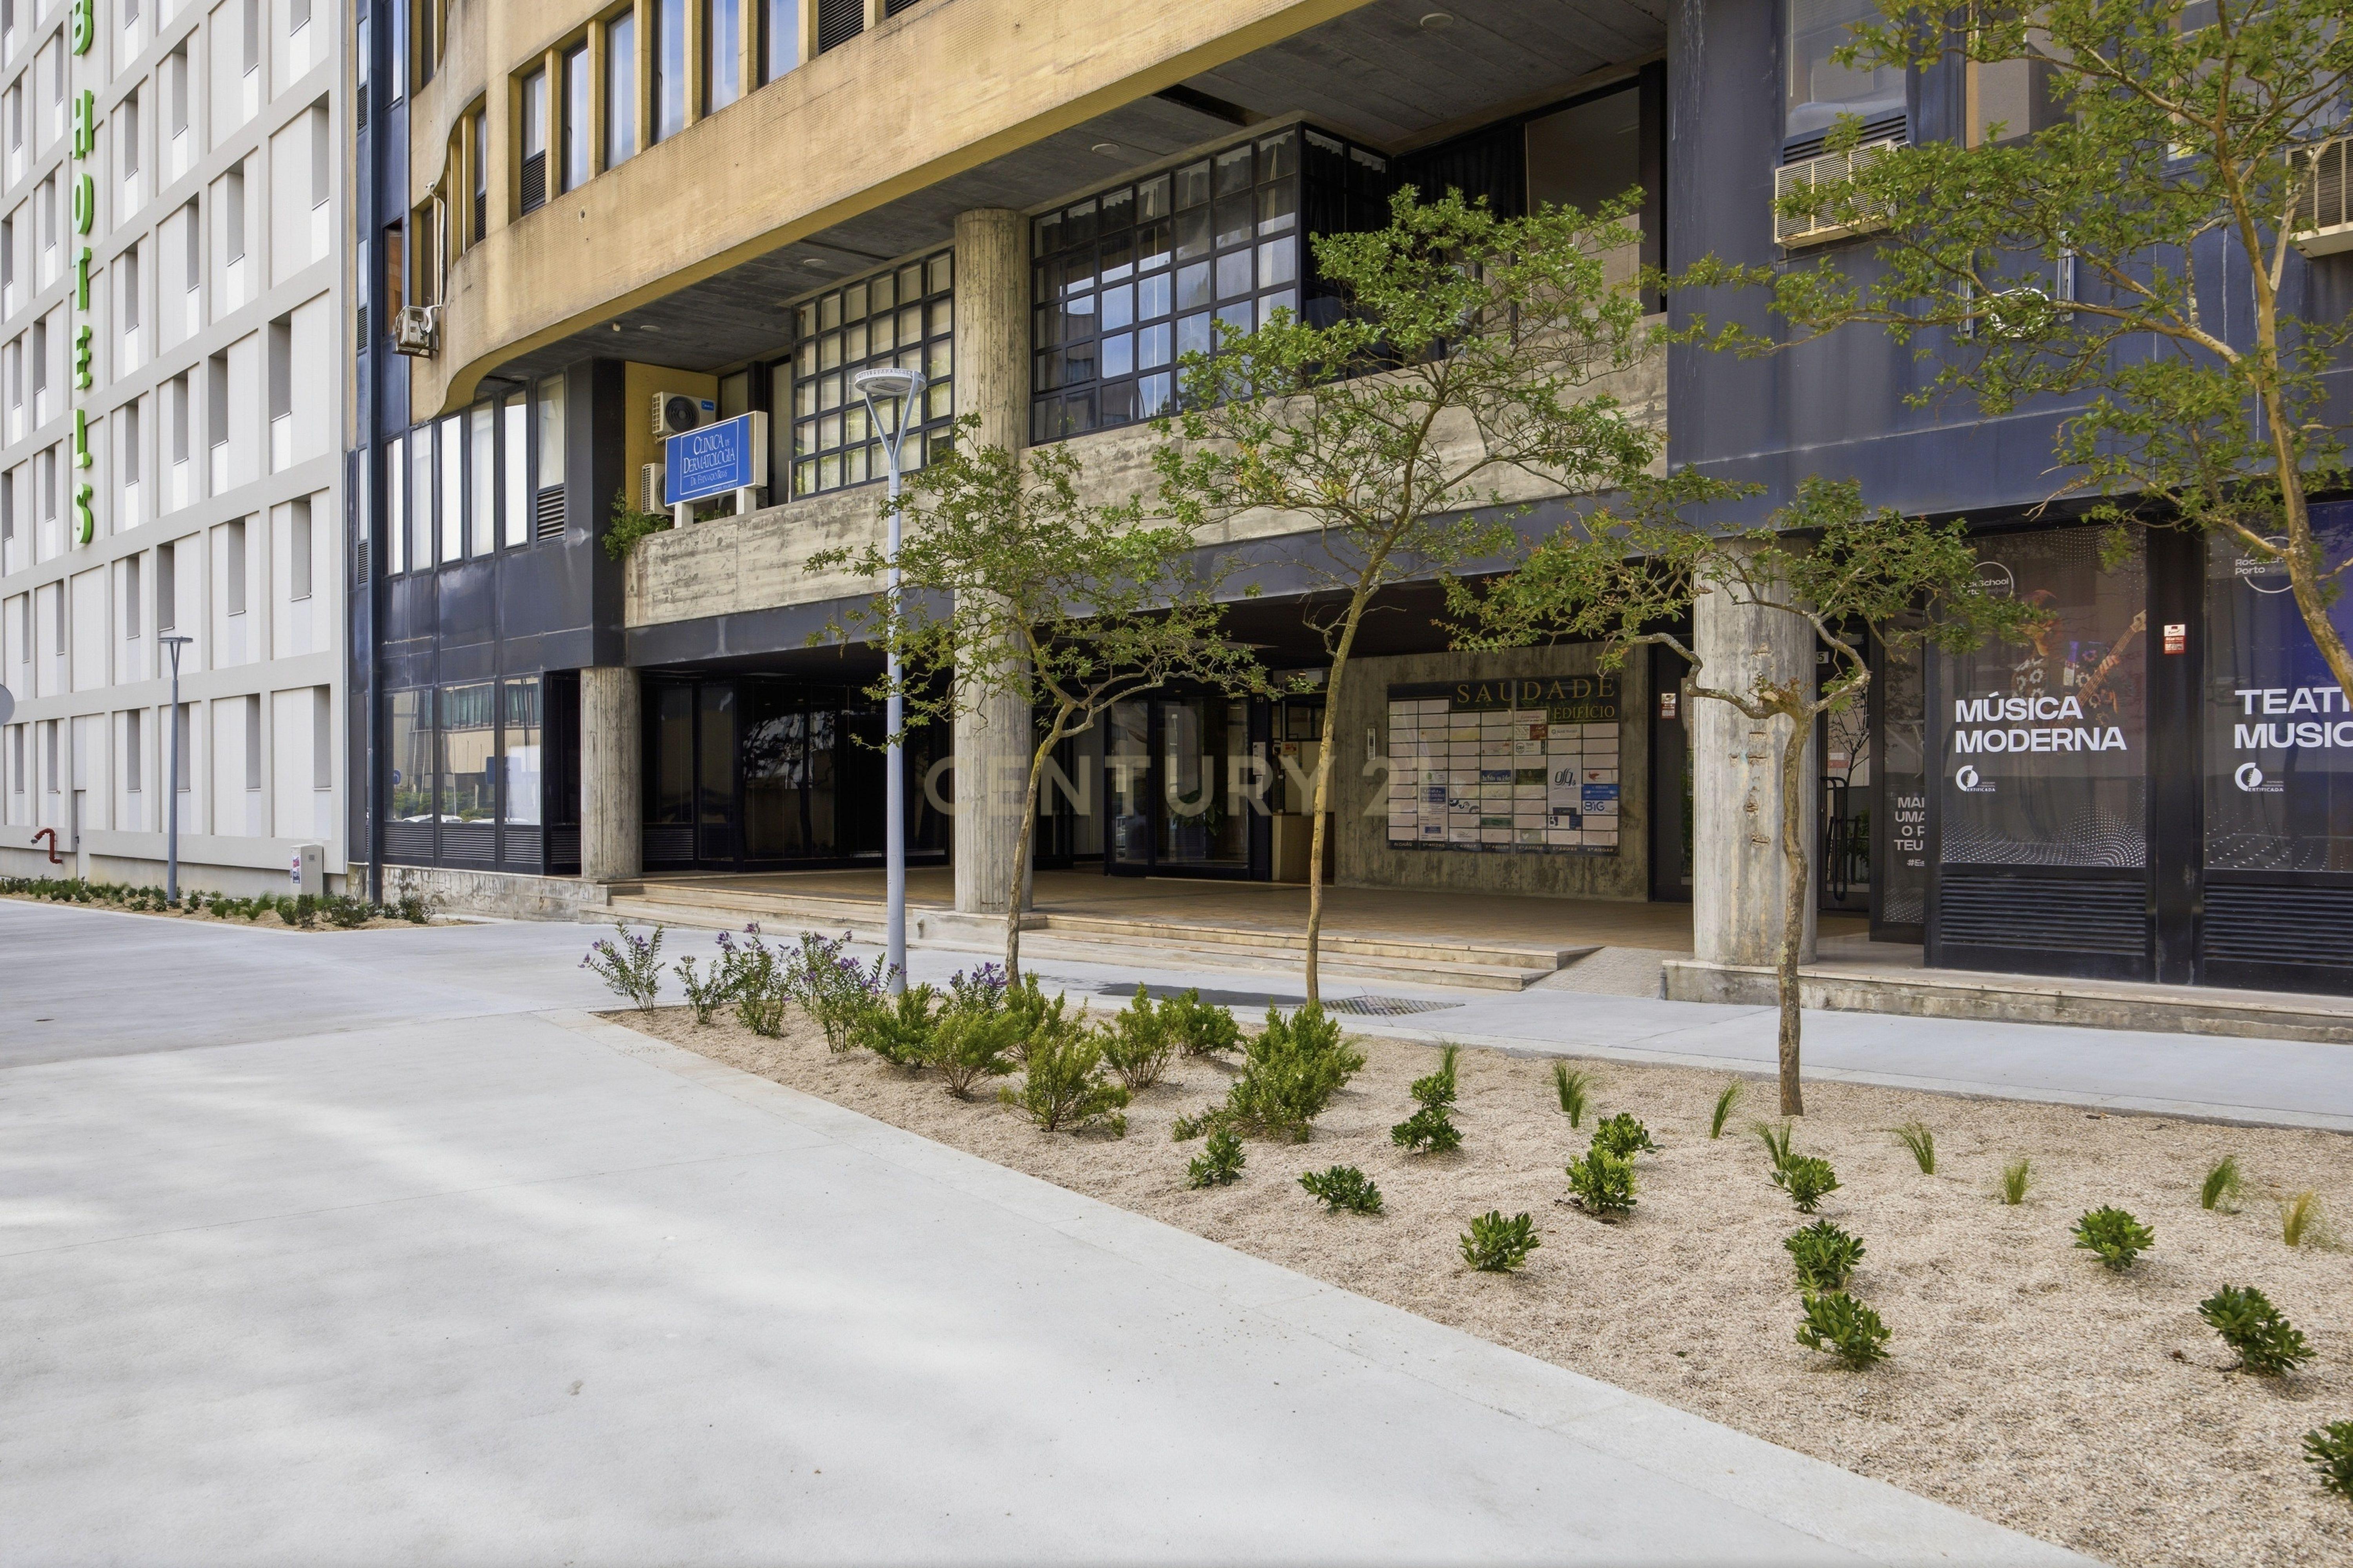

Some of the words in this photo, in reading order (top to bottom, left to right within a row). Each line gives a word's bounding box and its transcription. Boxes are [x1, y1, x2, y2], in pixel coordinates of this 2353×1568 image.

[72, 89, 94, 544] HOTELS
[683, 447, 735, 474] DERMATOLOGIA
[2235, 566, 2265, 575] Porto
[1457, 677, 1615, 703] SAUDADE
[1554, 704, 1615, 719] EDIFÍCIO
[1955, 691, 2084, 722] MÚSICA
[1955, 726, 2127, 753] MODERNA
[1902, 825, 1913, 837] O
[1894, 839, 1924, 851] TEU
